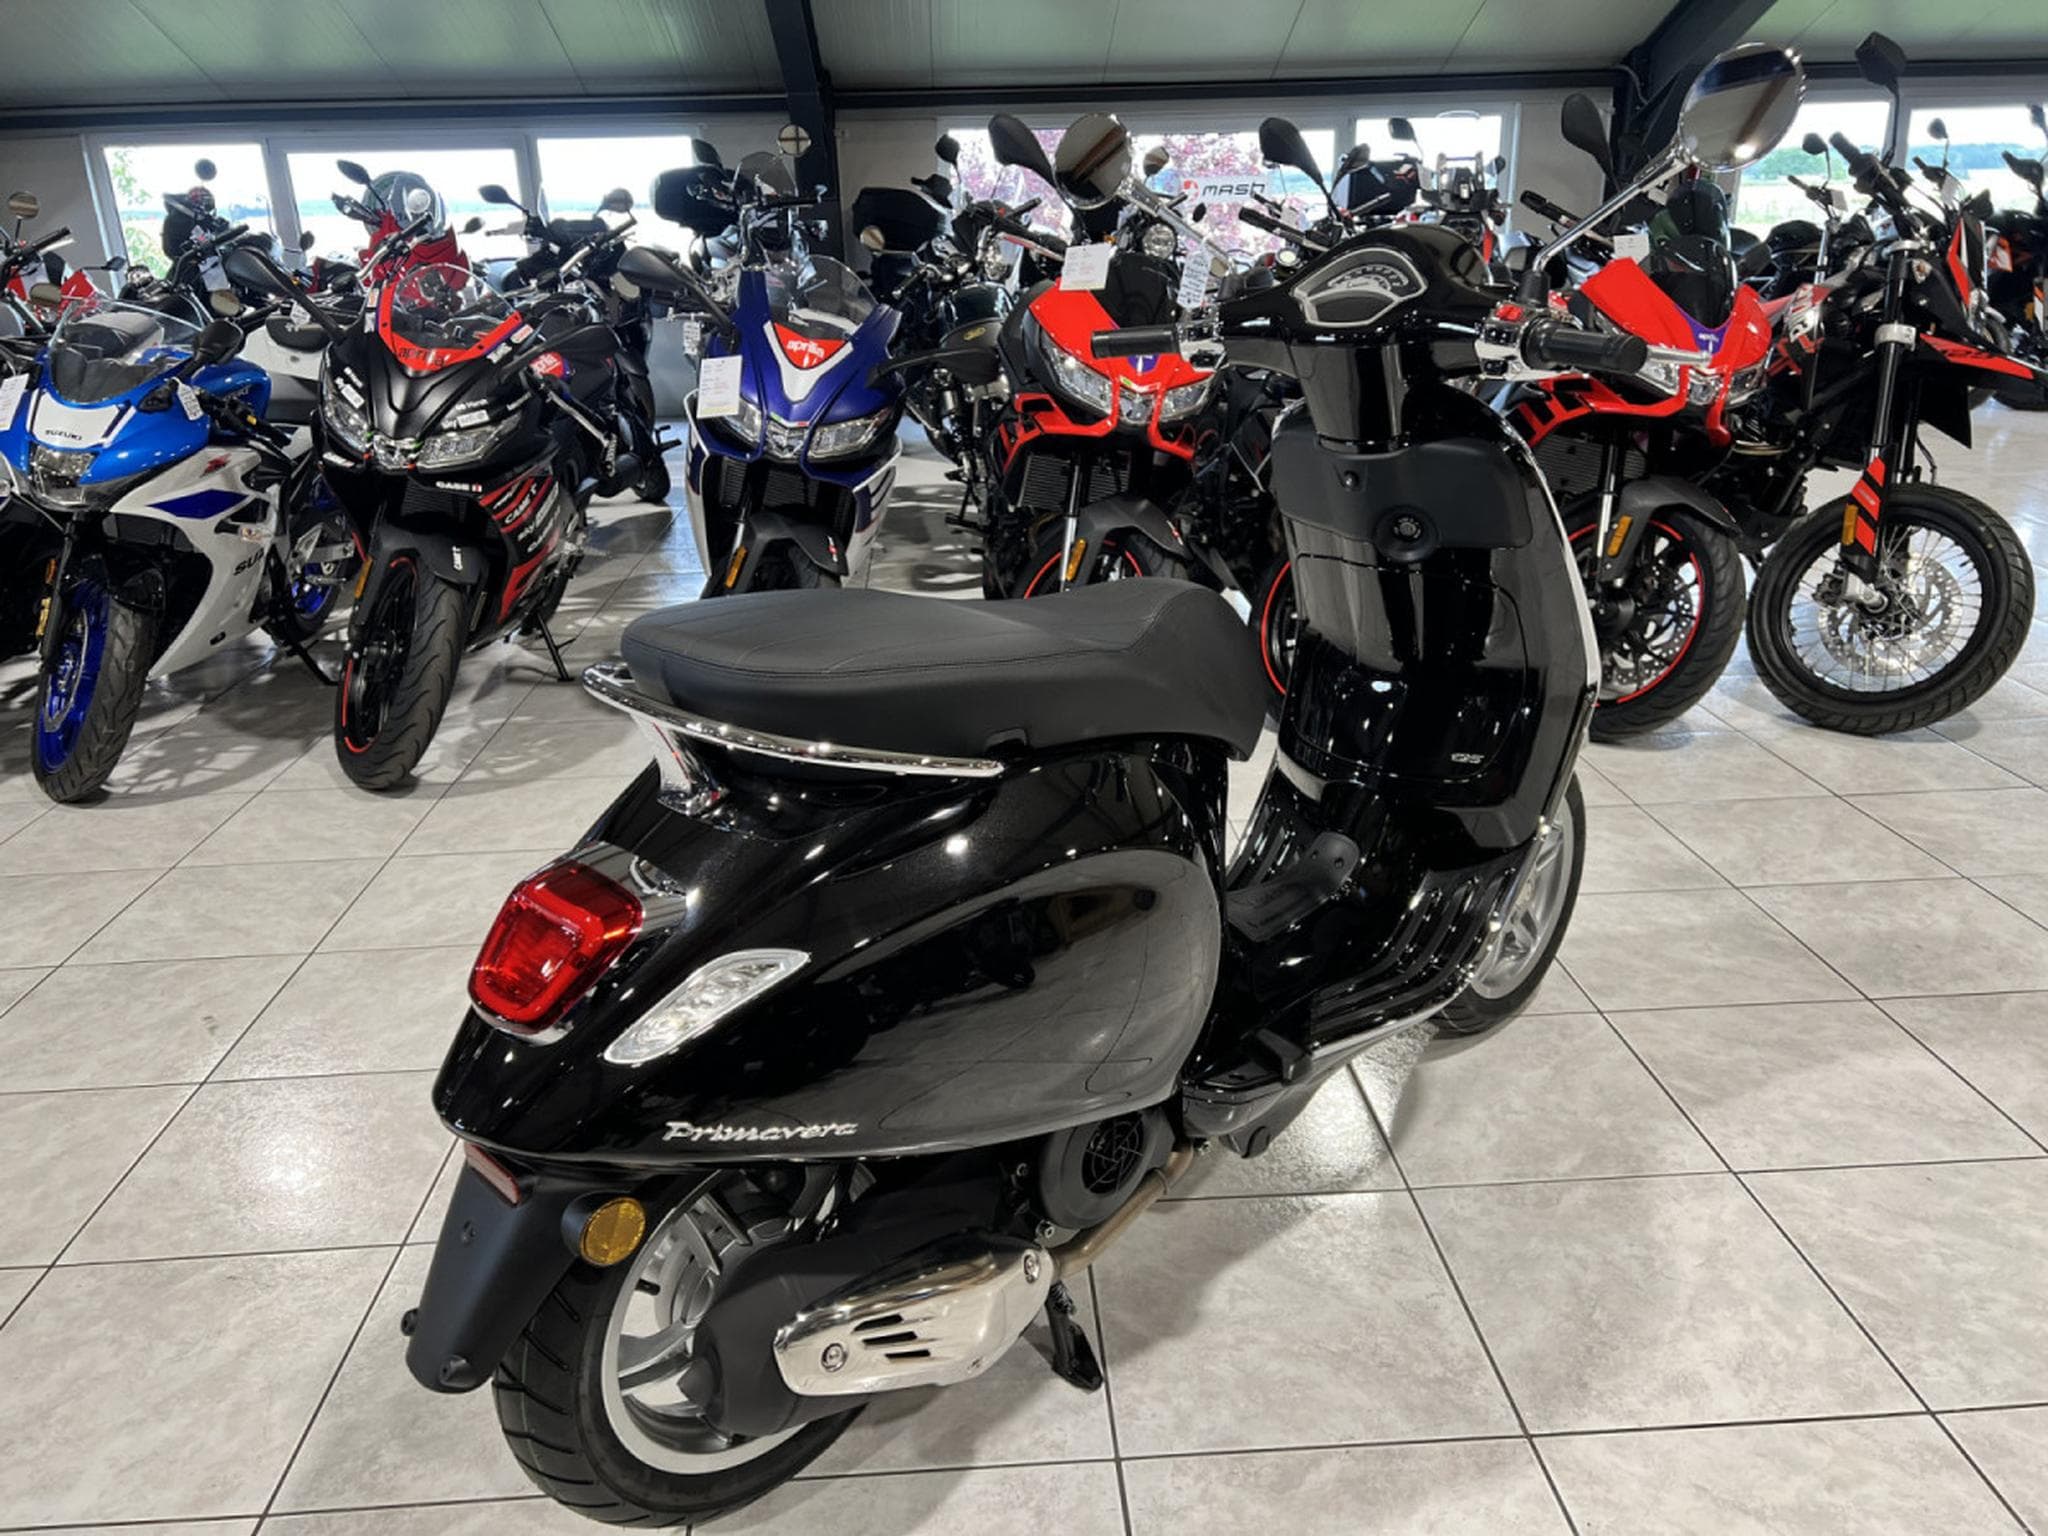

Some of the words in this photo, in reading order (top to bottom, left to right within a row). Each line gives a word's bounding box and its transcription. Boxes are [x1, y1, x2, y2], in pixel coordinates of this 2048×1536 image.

[787, 340, 825, 358] aprilia
[45, 429, 82, 441] SUZUKI
[662, 1121, 859, 1141] Primavera
